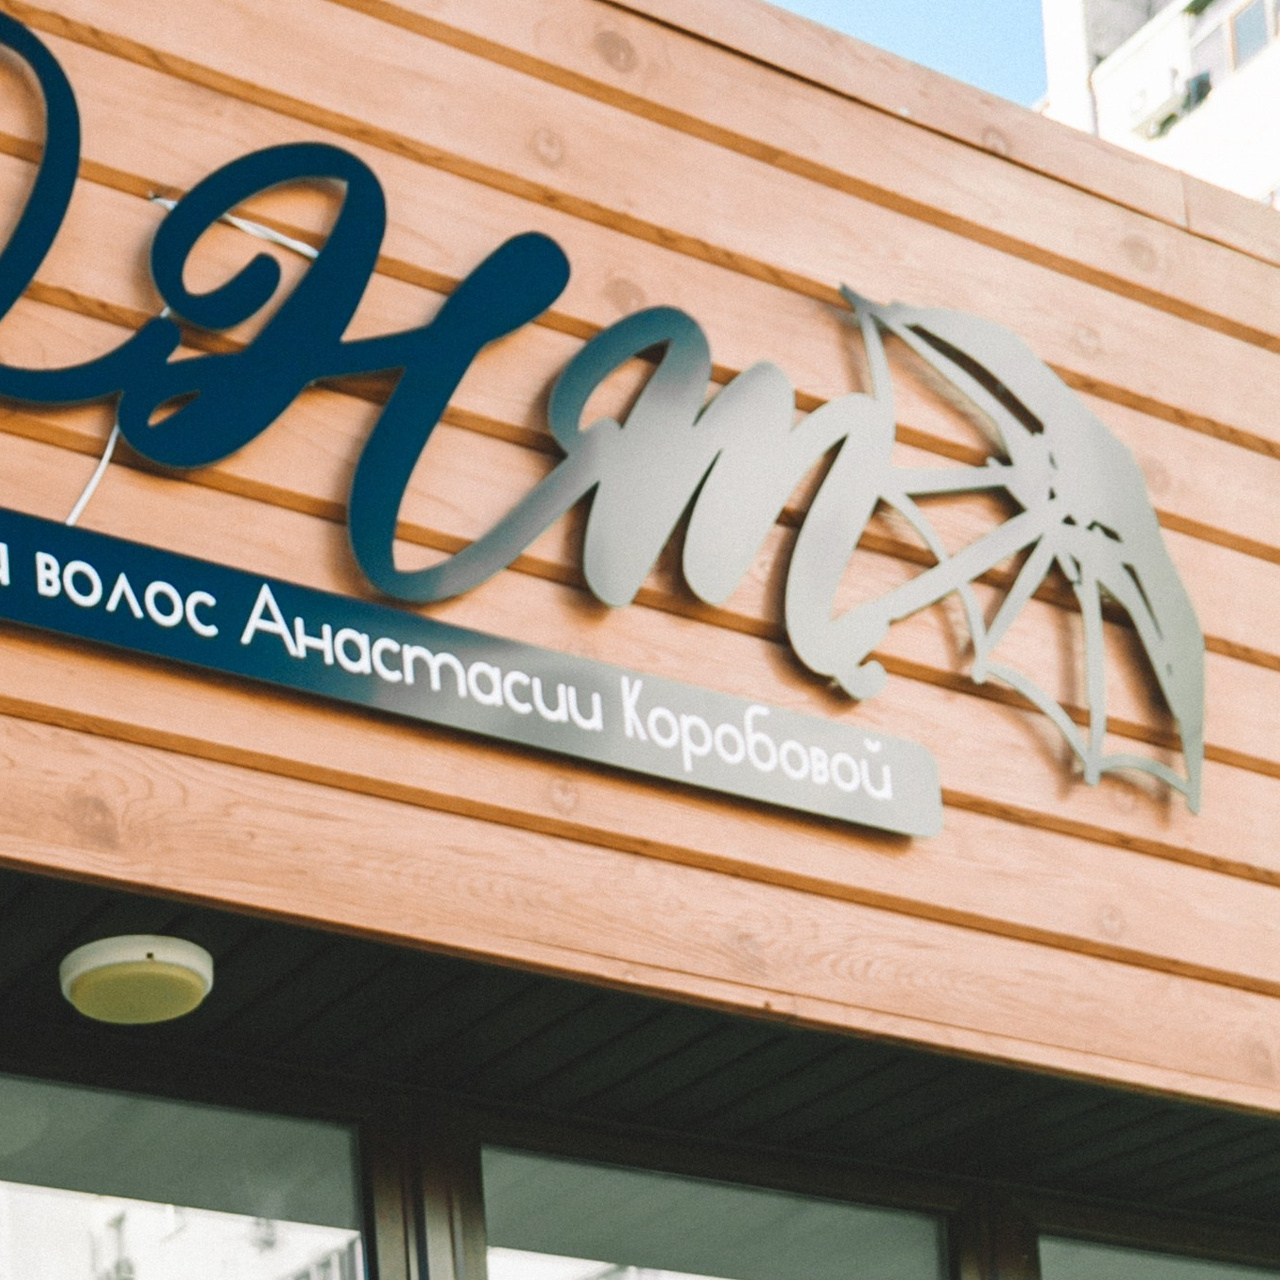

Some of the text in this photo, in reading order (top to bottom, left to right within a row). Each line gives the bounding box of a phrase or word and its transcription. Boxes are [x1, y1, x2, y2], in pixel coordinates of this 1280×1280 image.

[33, 549, 219, 640] волос
[239, 580, 605, 734] Анастасии
[619, 674, 895, 803] Коробовой
